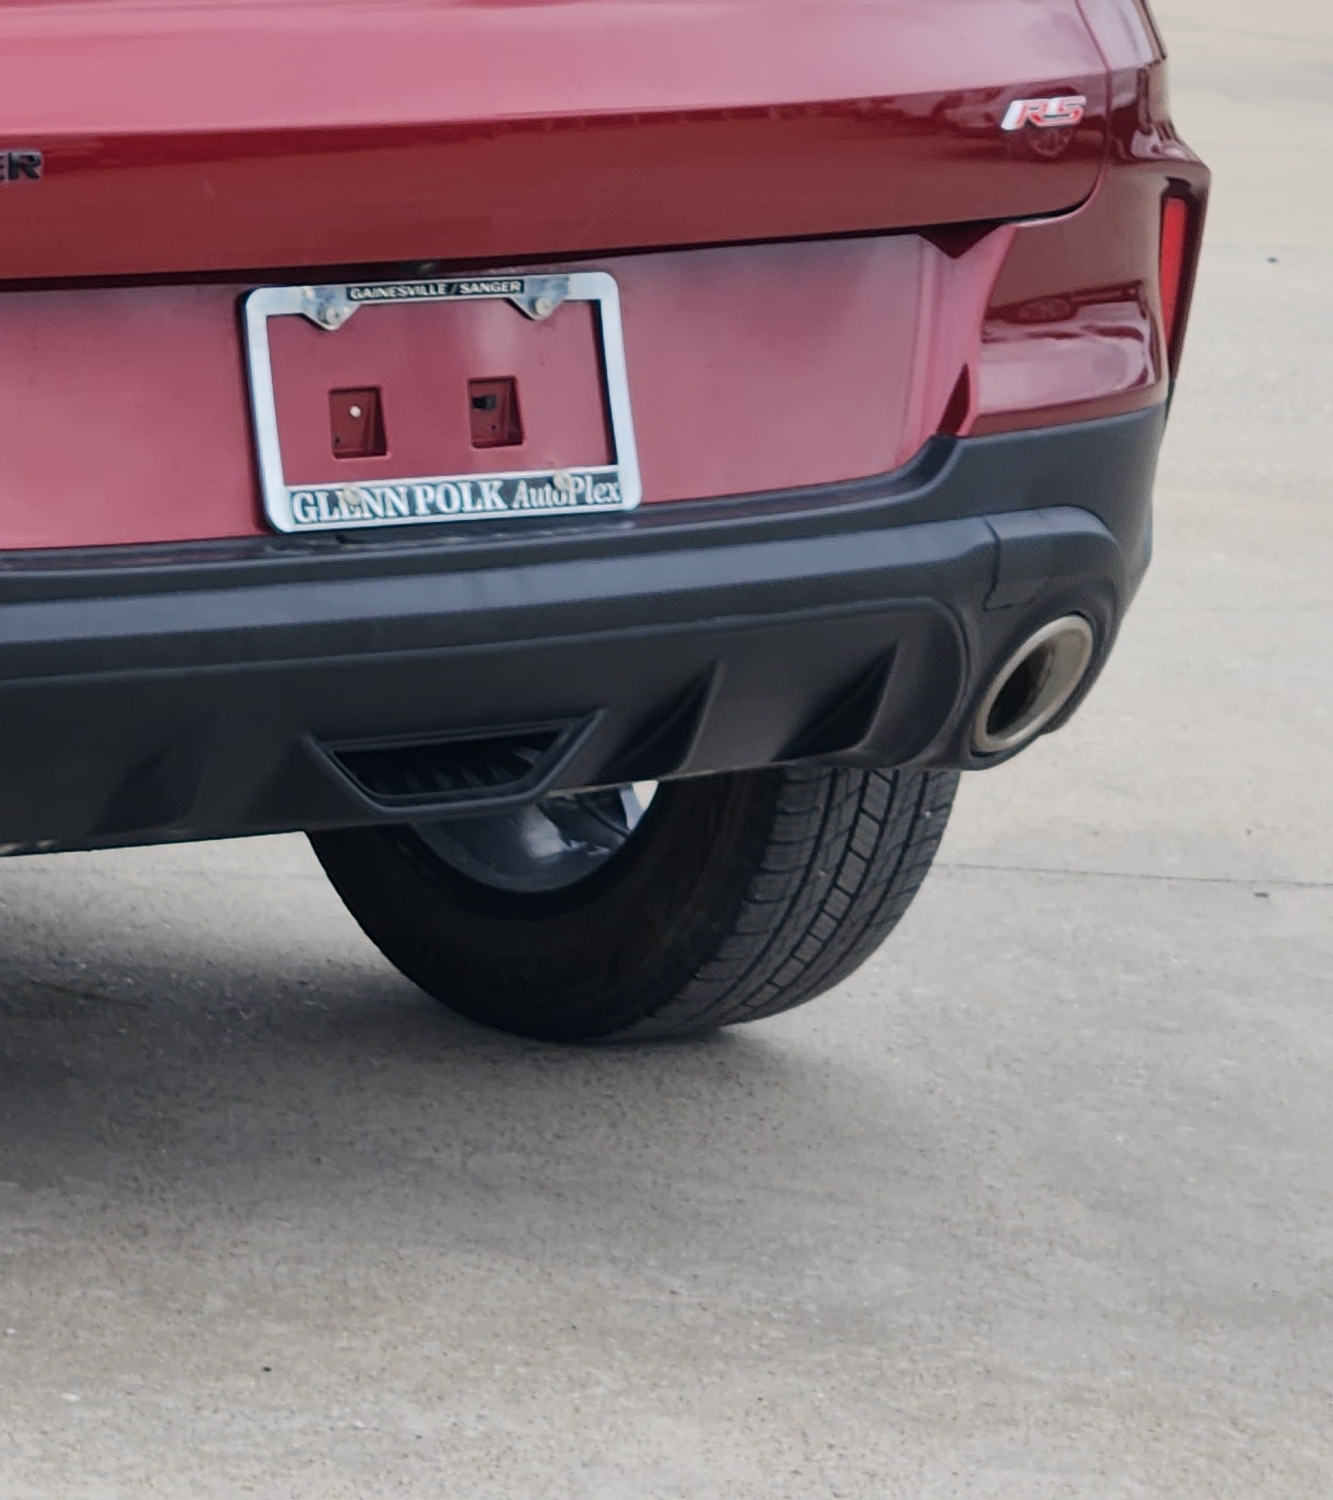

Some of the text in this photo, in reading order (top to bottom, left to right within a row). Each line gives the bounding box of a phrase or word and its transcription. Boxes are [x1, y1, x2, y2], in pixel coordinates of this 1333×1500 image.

[1000, 96, 1087, 130] RS
[349, 284, 447, 300] GAINESVILLE
[459, 281, 521, 294] SANGER
[414, 478, 503, 514] POLK
